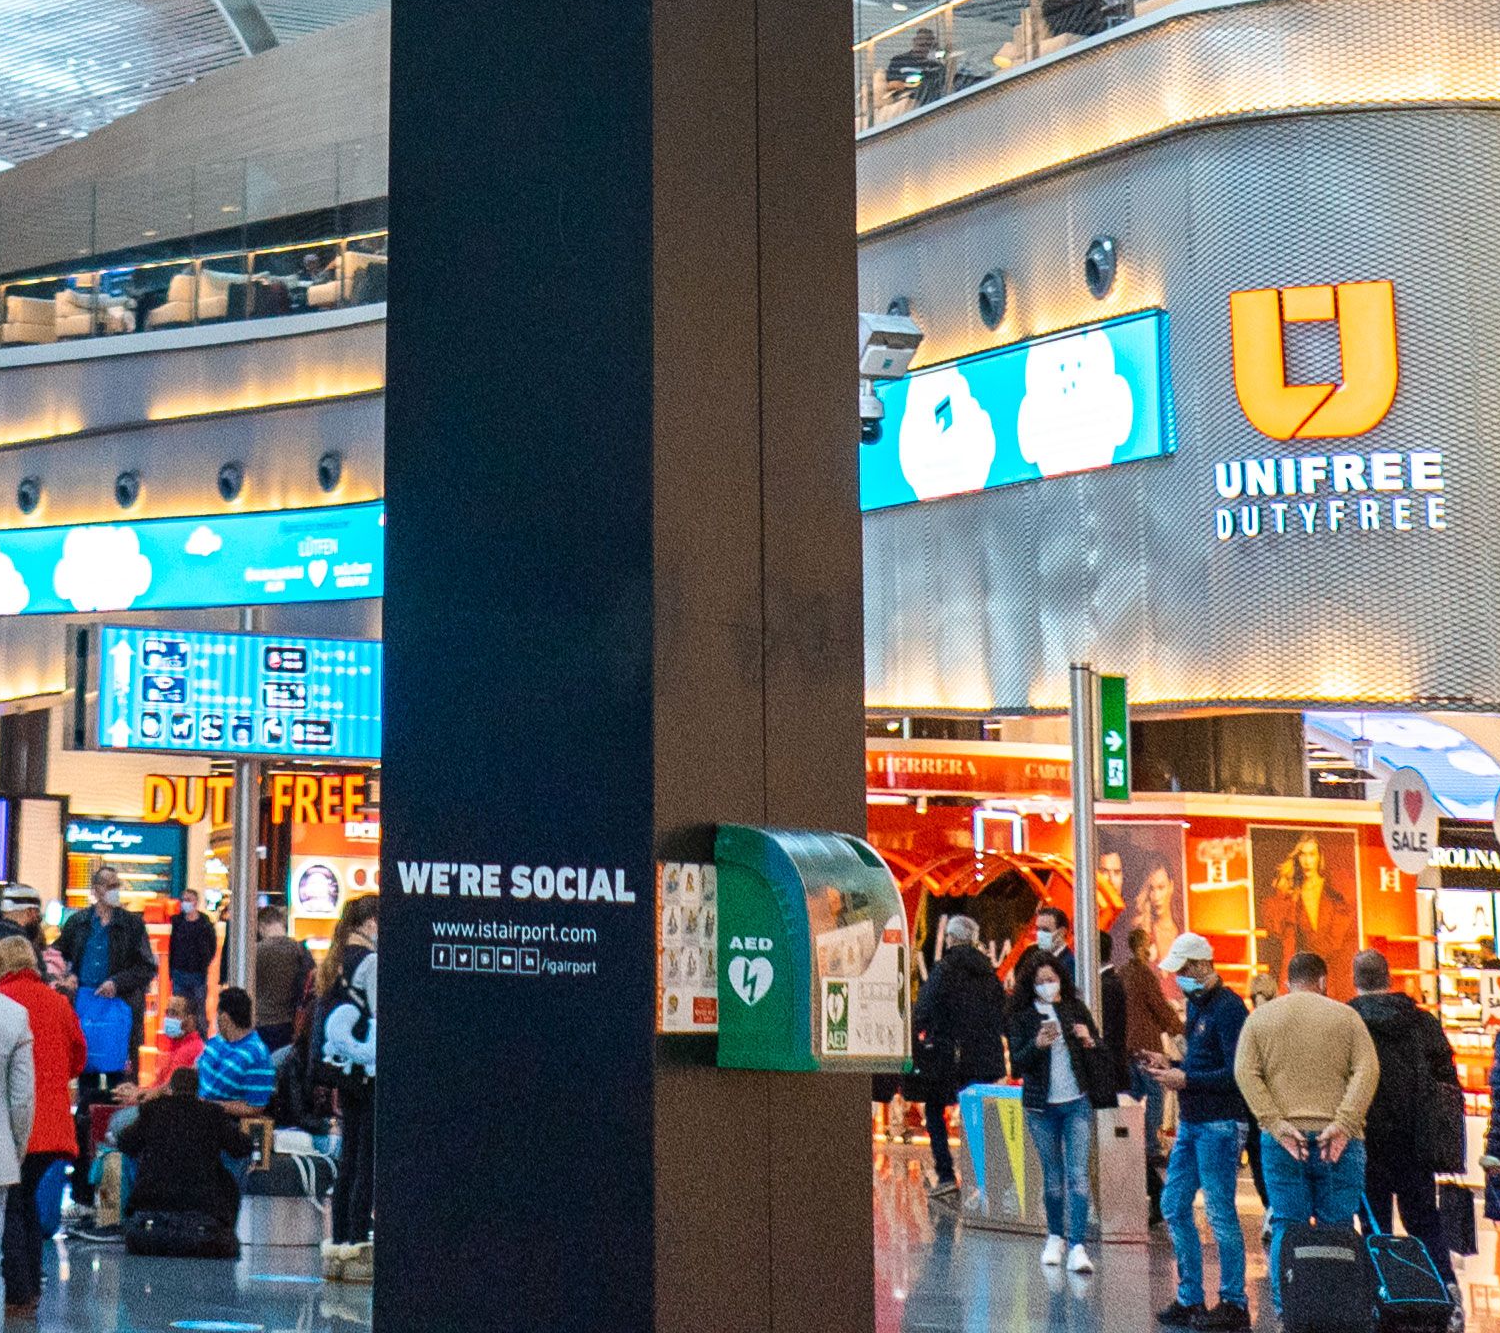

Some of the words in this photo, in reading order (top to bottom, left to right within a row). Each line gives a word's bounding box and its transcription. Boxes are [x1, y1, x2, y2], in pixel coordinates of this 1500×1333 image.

[1215, 451, 1445, 498] UNIFREE
[1215, 497, 1447, 541] DUTYFREE
[143, 774, 236, 826] DUT
[271, 773, 366, 825] FREE
[1393, 789, 1401, 825] I
[1391, 830, 1429, 853] SALE
[397, 860, 502, 898] WE'RE
[509, 864, 636, 903] SOCIAL
[431, 918, 597, 944] www.istairport.com
[728, 936, 774, 952] AED
[827, 1030, 849, 1052] AED
